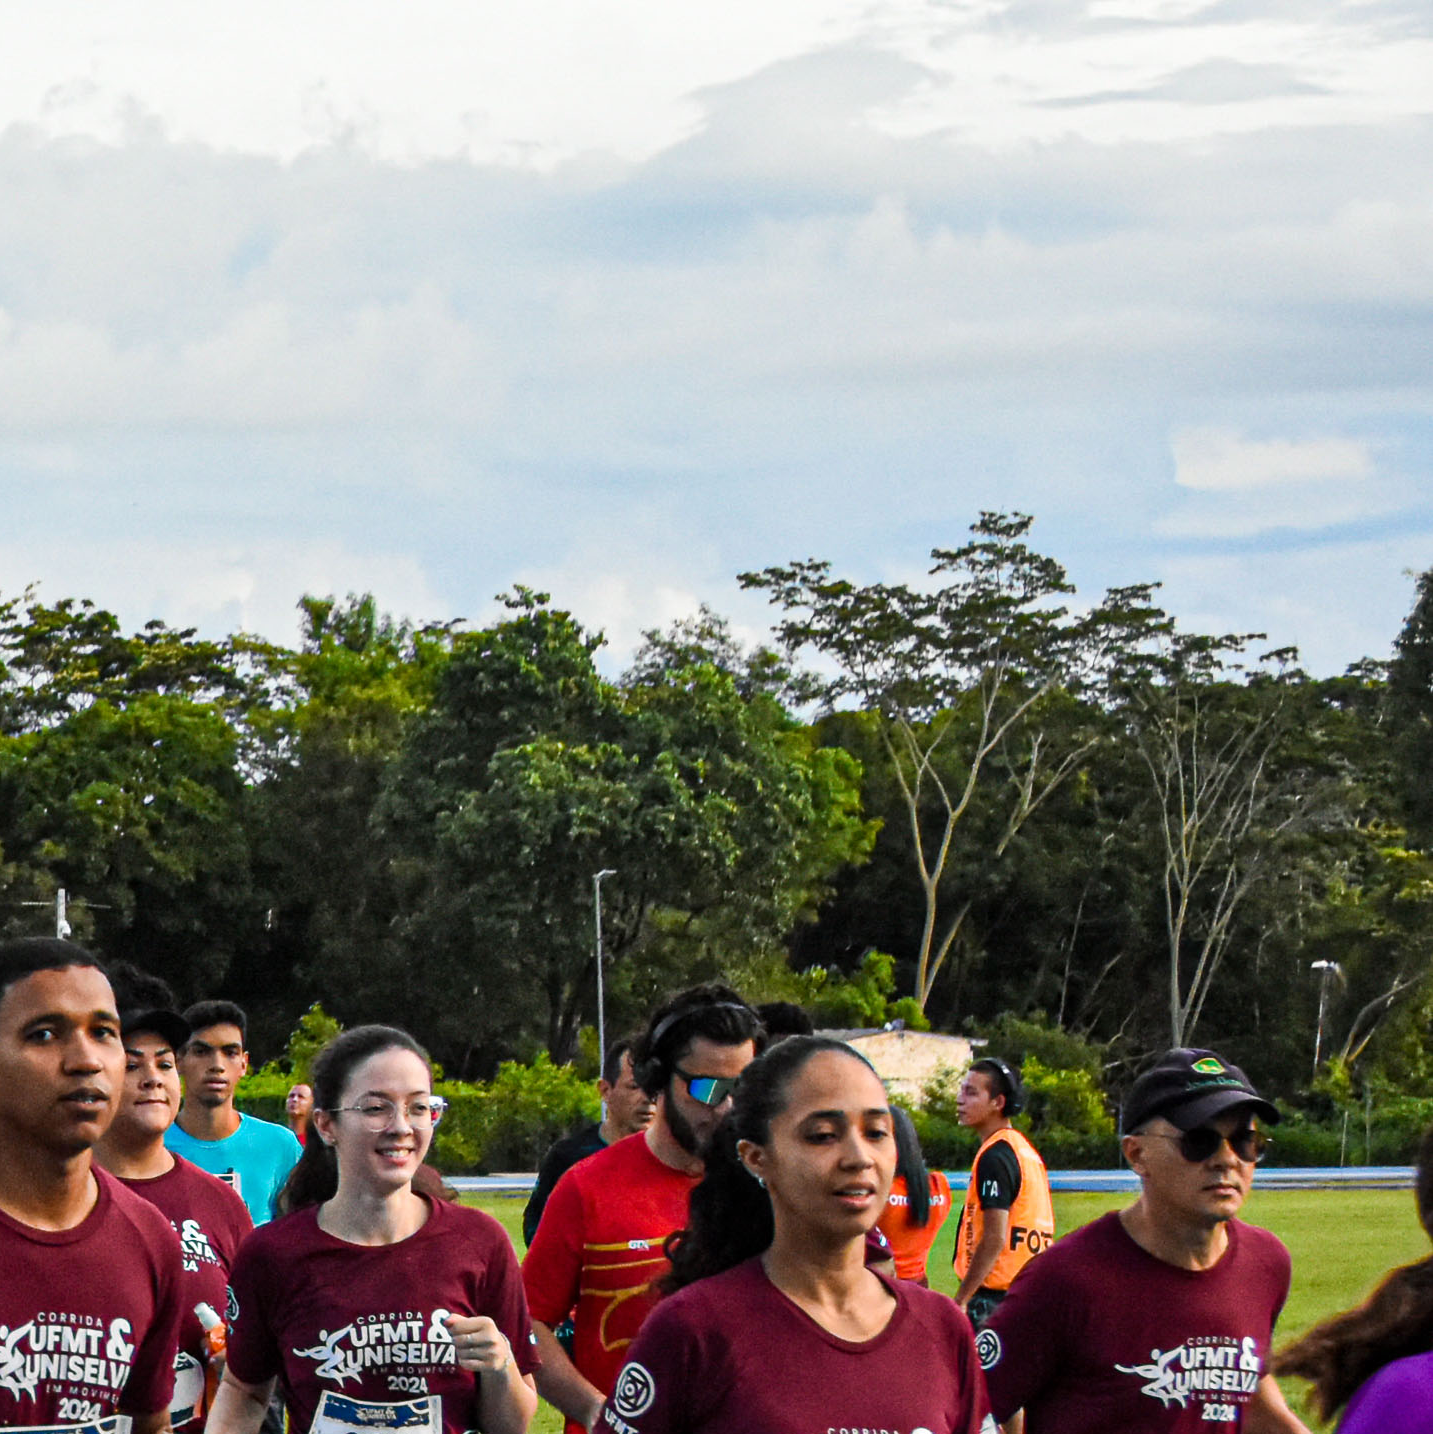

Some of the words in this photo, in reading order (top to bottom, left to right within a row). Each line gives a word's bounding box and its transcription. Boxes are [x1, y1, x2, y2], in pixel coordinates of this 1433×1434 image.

[182, 1220, 208, 1243] &
[38, 1312, 103, 1328] CORRIDA
[350, 1321, 424, 1348] UFMT
[427, 1308, 453, 1343] &
[357, 1312, 423, 1325] CORRIDA
[30, 1325, 103, 1355] UFMT
[106, 1318, 135, 1363] &
[1187, 1336, 1239, 1346] CORRIDA
[347, 1343, 456, 1368] UNISELVA
[1180, 1347, 1238, 1369] UFMT
[1240, 1336, 1259, 1372] &
[387, 1376, 429, 1394] 2024
[58, 1397, 102, 1421] 2024
[1201, 1403, 1237, 1421] 2024
